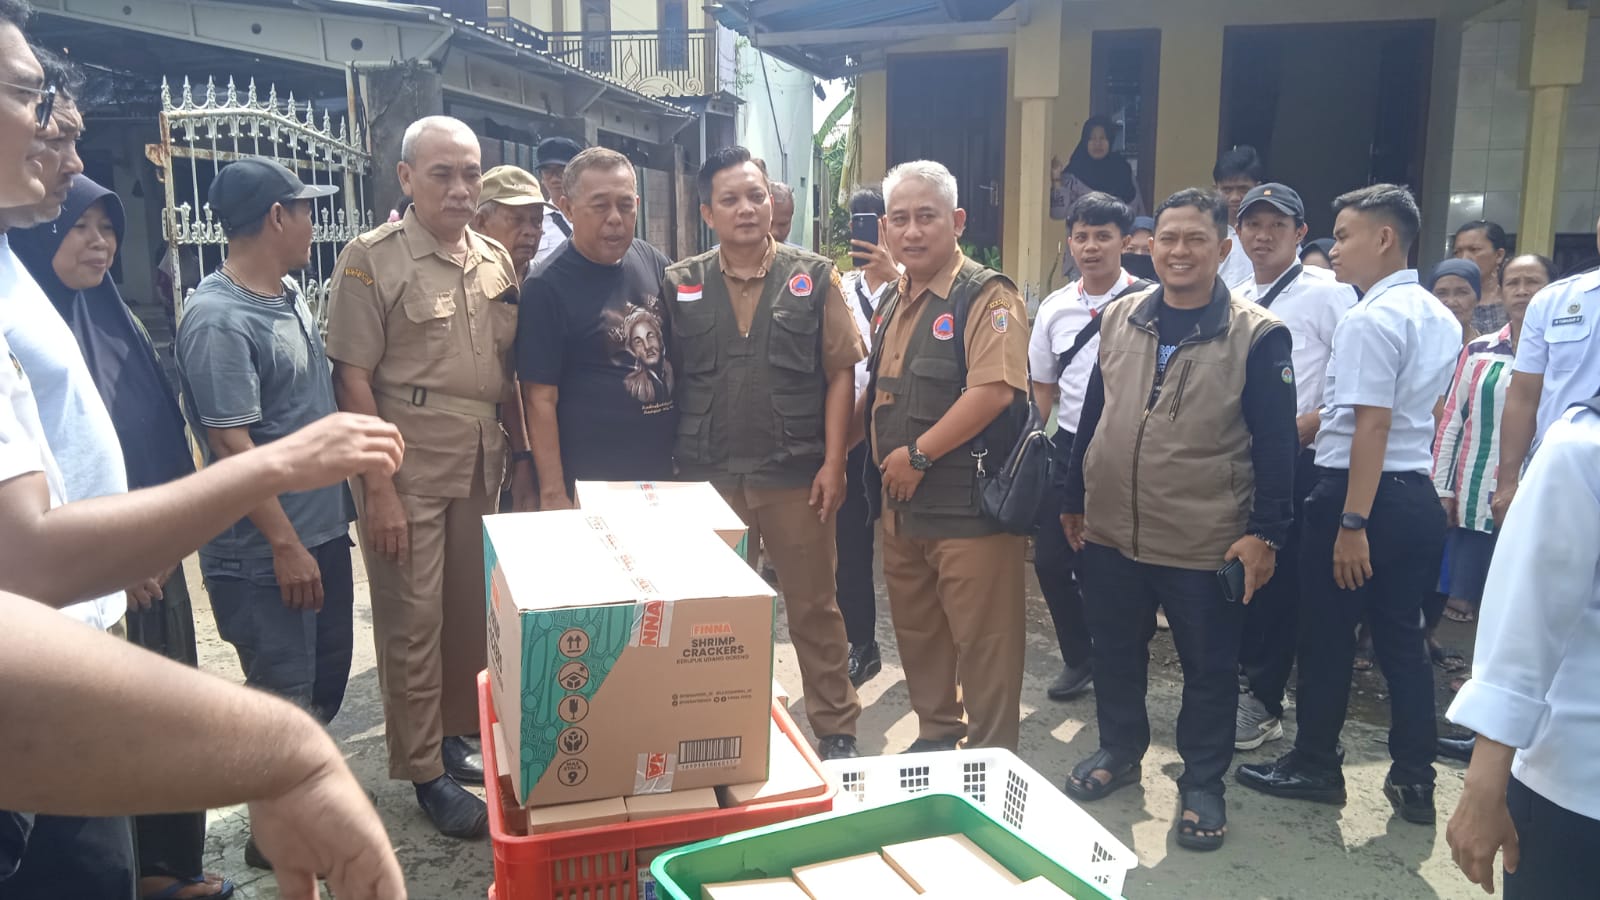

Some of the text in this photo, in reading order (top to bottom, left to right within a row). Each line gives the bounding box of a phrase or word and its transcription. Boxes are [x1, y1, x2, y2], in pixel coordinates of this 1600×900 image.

[693, 624, 733, 635] FINNA
[691, 636, 736, 648] SHRIMP
[682, 645, 745, 657] CRACKERS
[567, 771, 578, 783] 9
